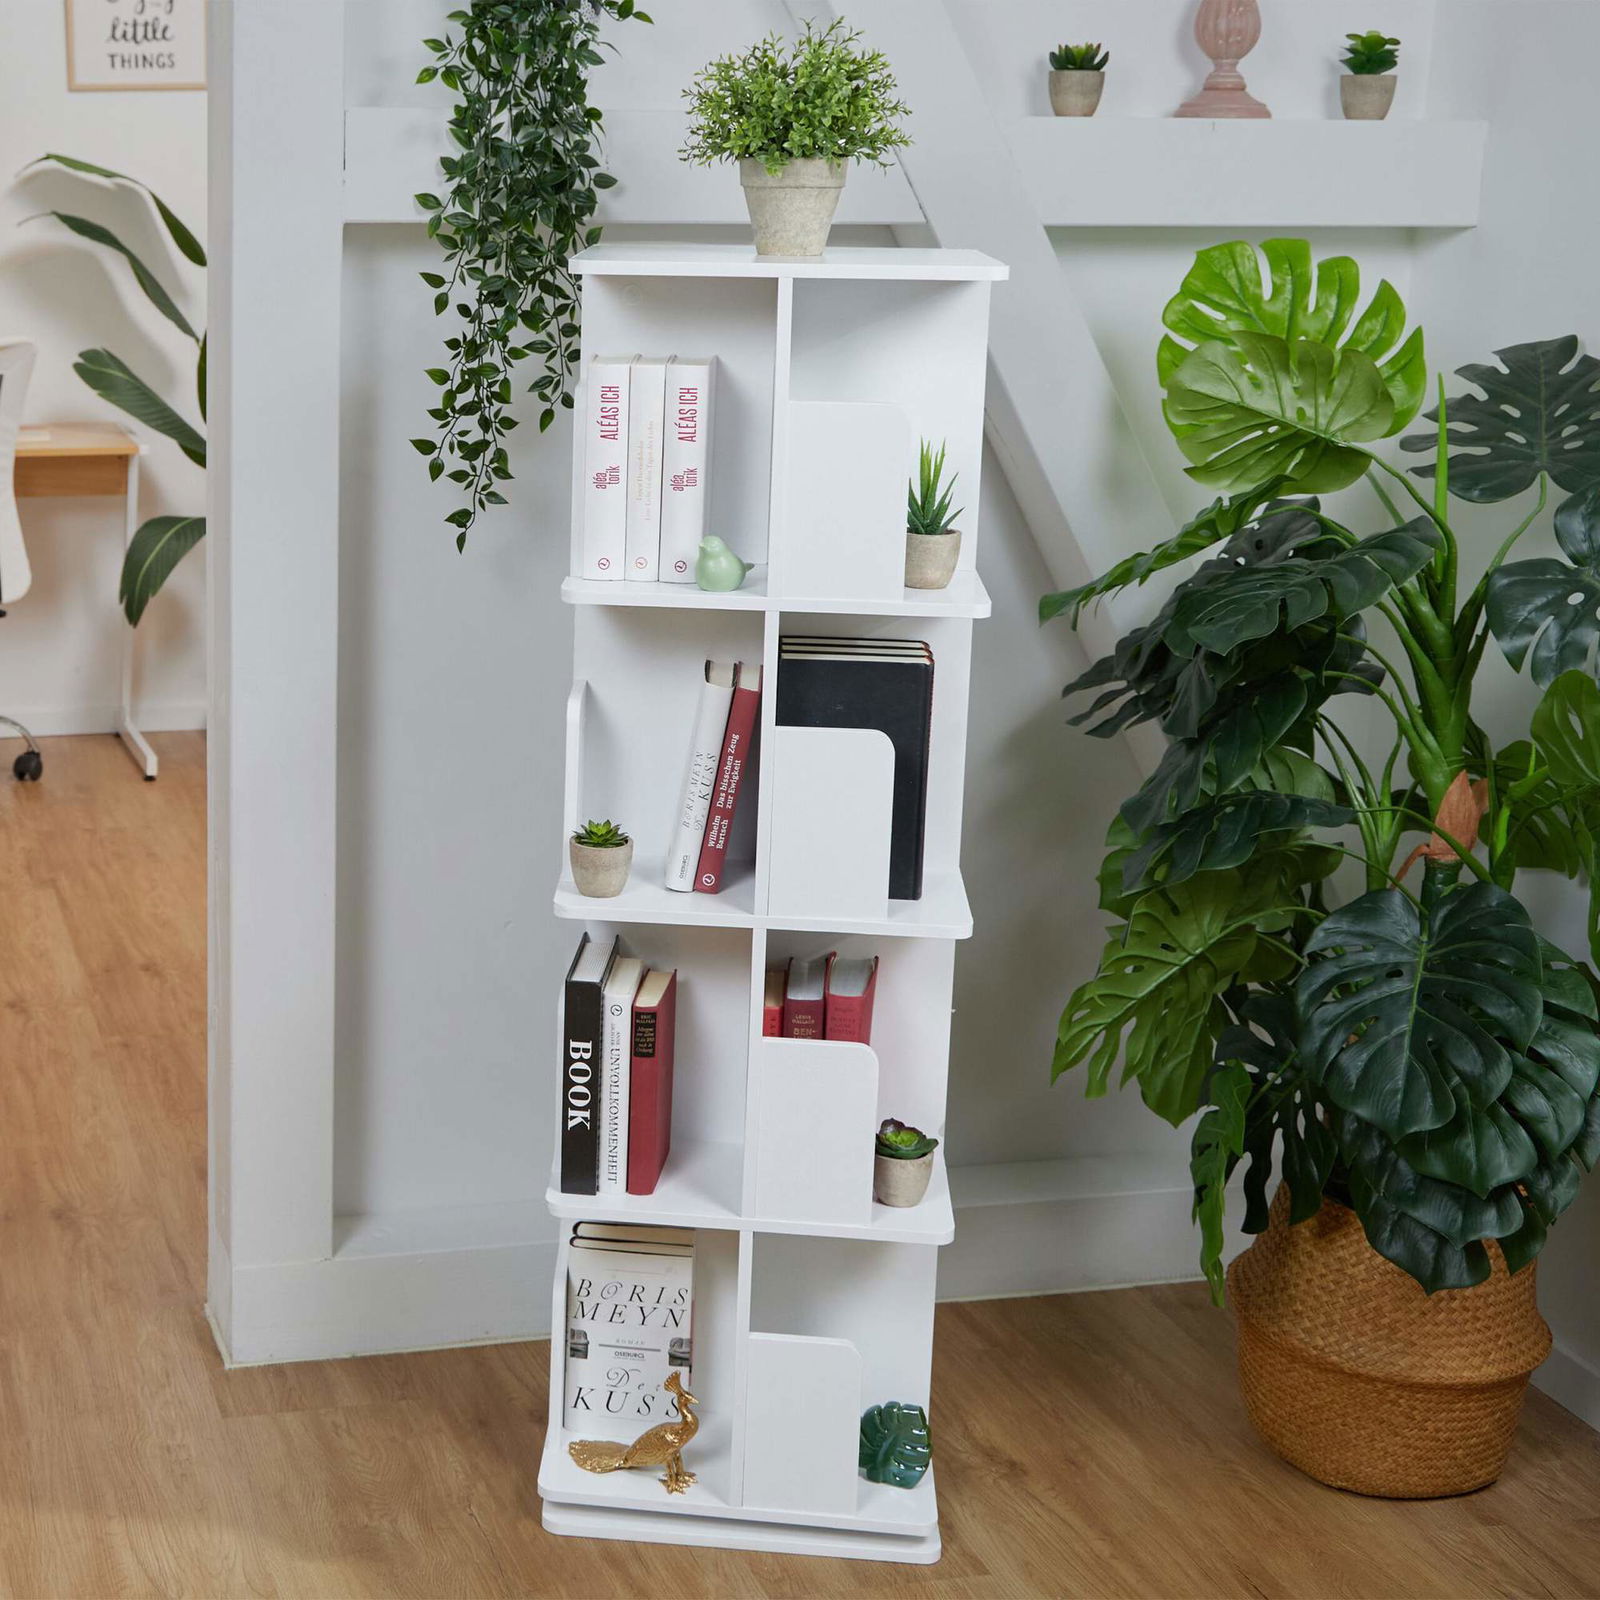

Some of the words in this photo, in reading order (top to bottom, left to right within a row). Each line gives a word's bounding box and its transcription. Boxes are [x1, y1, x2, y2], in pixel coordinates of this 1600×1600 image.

[106, 15, 175, 45] little
[107, 53, 175, 69] THINGS
[600, 386, 620, 403] ICH
[679, 387, 698, 405] ICH
[596, 407, 619, 440] ALÉAS
[674, 408, 697, 442] ALÉAS
[593, 472, 607, 490] aléa
[606, 465, 620, 485] torik
[670, 474, 684, 491] aléa
[683, 468, 698, 487] torik
[728, 733, 740, 754] Zeug
[698, 752, 716, 800] KUSS
[719, 755, 733, 791] bisschen
[728, 759, 742, 793] Ewigkeit
[716, 792, 725, 808] Das
[726, 795, 734, 809] zur
[708, 815, 721, 847] Wilhelm
[716, 819, 729, 849] Bartsch
[568, 1039, 593, 1131] BOOK
[608, 1048, 621, 1184] UNVOLLKOMMENHEIT
[576, 1278, 688, 1306] BORIS
[573, 1300, 687, 1328] MEYN
[606, 1366, 661, 1392] Der
[571, 1386, 679, 1418] KUSS
